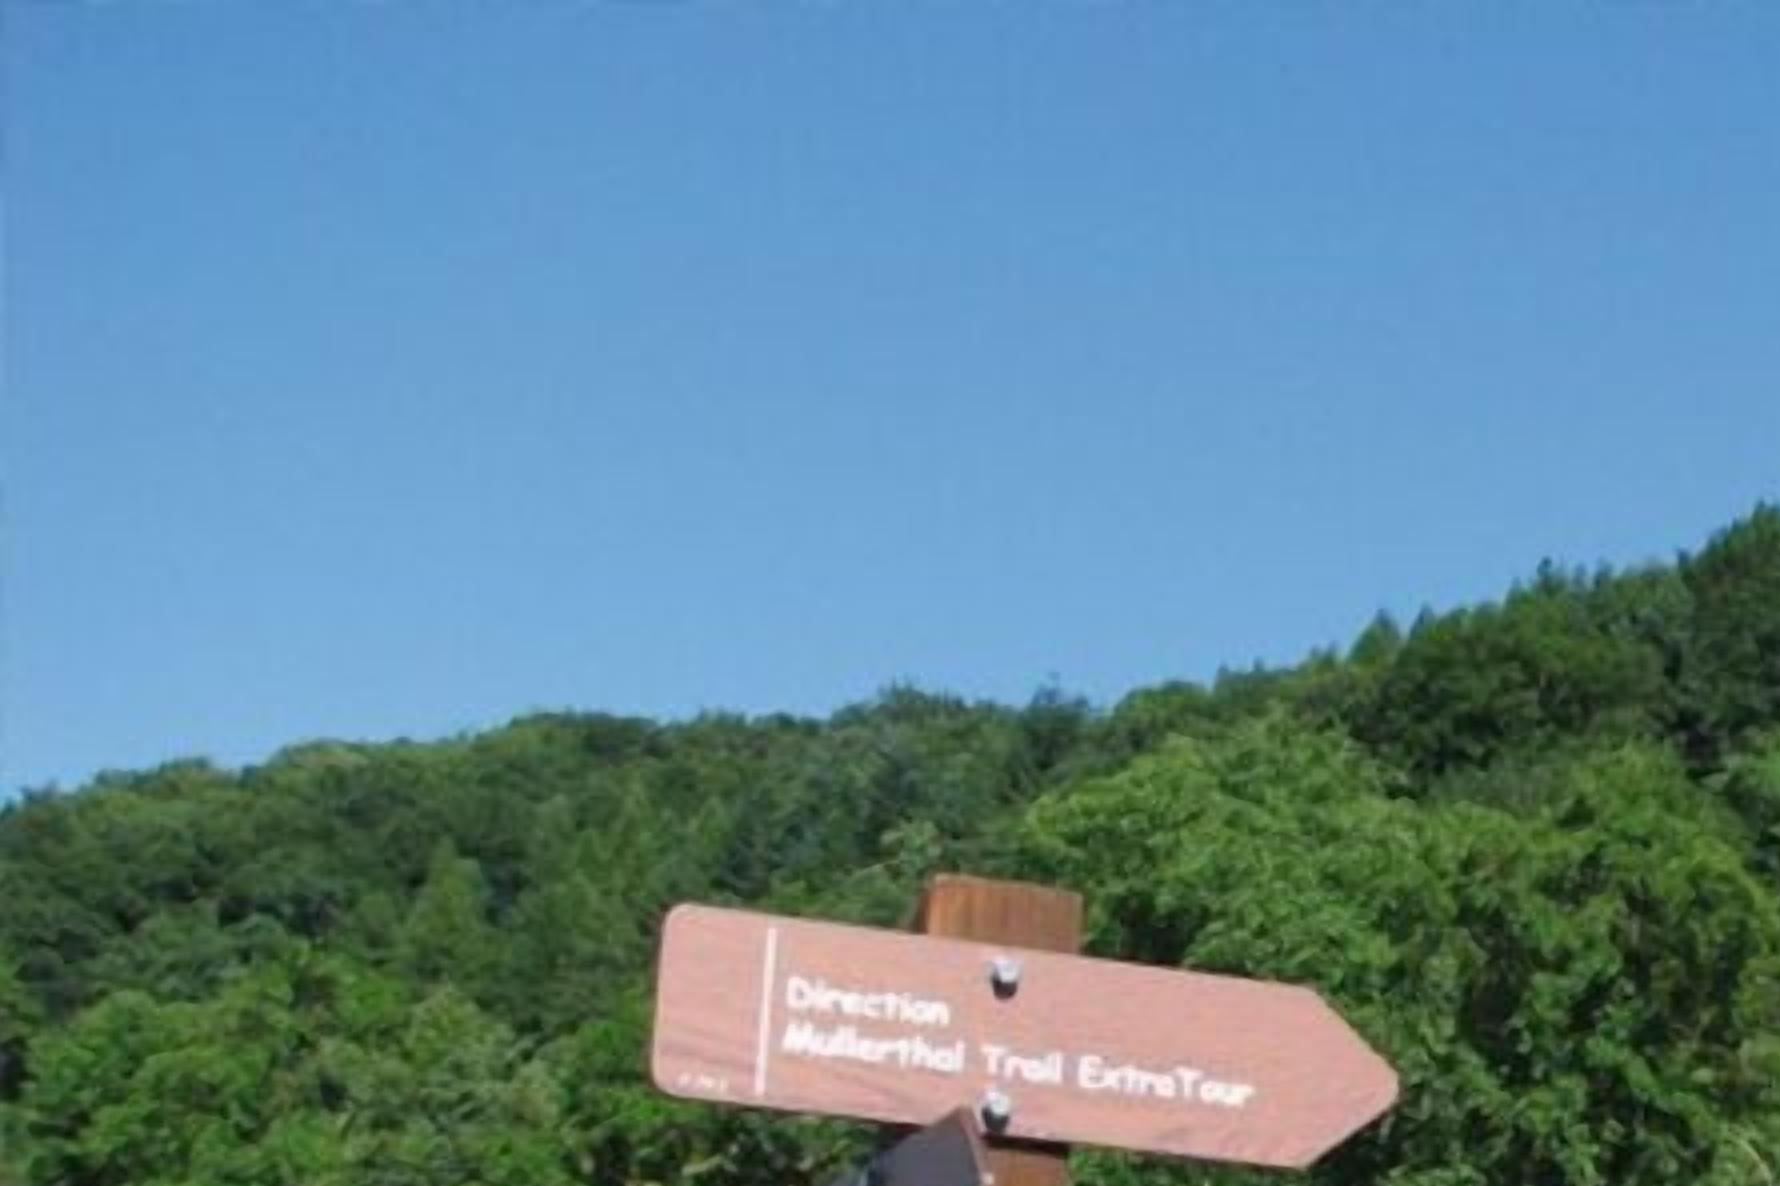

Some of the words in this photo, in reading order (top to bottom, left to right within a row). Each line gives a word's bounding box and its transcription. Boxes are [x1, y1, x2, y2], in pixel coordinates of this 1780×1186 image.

[787, 975, 950, 1026] Direction
[782, 1022, 965, 1072] Mullerthal
[981, 1044, 1063, 1083] Trail
